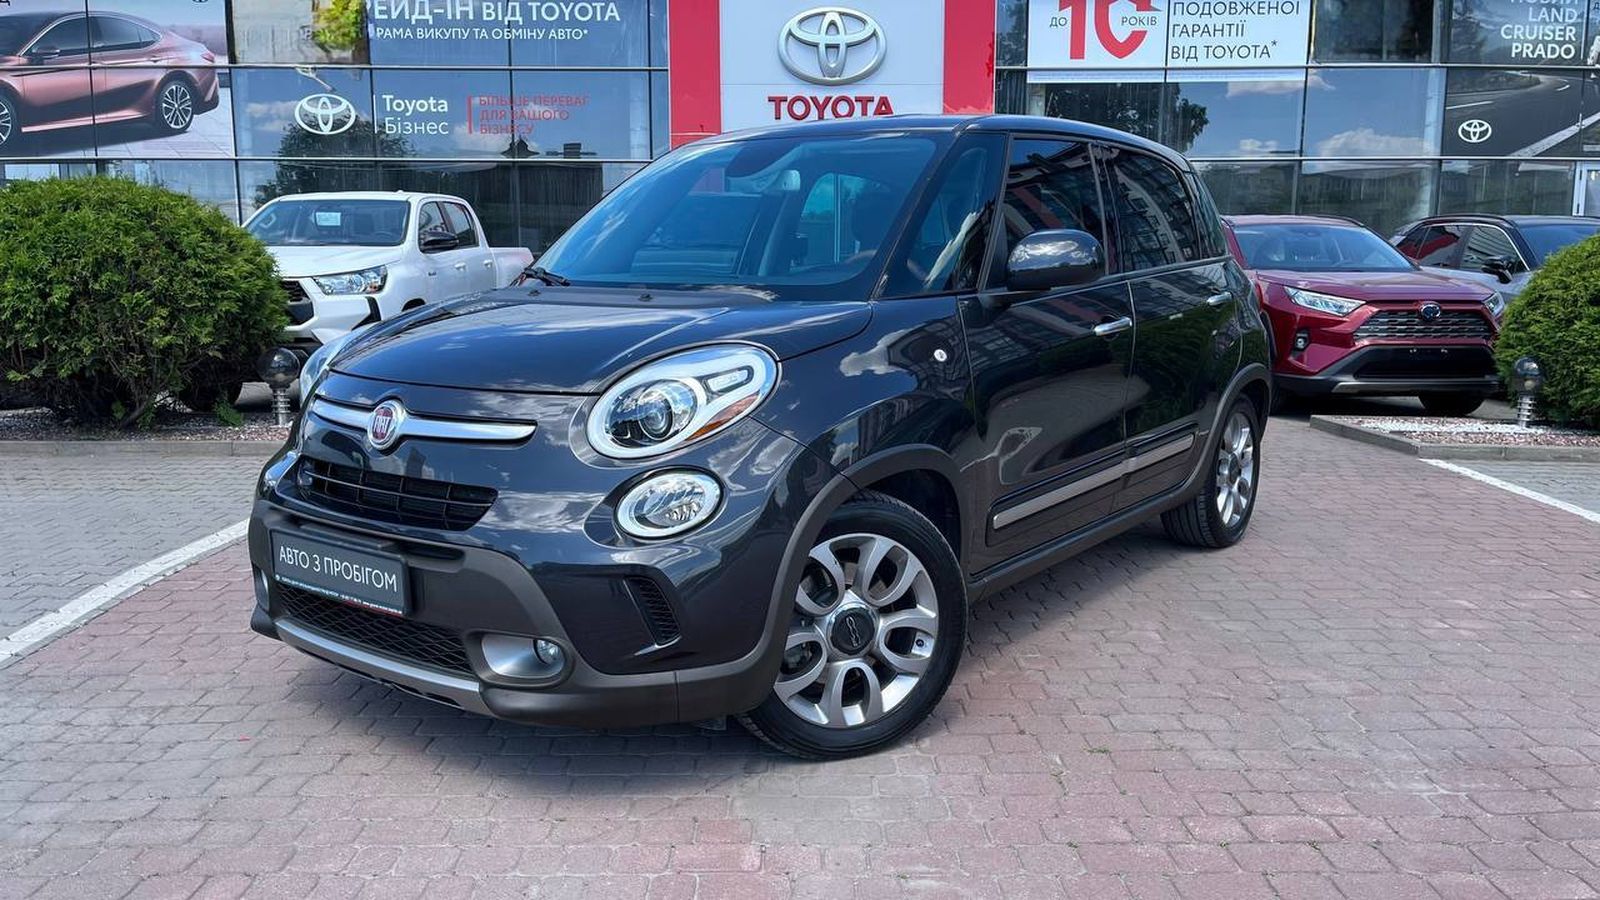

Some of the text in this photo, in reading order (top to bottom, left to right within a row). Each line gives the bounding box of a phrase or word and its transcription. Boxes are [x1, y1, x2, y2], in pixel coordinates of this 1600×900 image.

[482, 2, 523, 24] ВІД
[528, 2, 621, 21] TOYOTA
[1121, 16, 1157, 26] РОКІВ
[1529, 7, 1577, 22] LAND
[1049, 17, 1068, 27] ДО
[1172, 20, 1246, 38] ГАРАНТІЇ
[417, 28, 470, 40] ВИКУПУ
[473, 28, 489, 40] ТА
[492, 28, 546, 40] ОБМІНУ
[1501, 25, 1576, 41] CRUISER
[1171, 45, 1198, 62] ВІД
[1511, 43, 1576, 59] PRADO
[382, 94, 448, 116] Toyota
[768, 95, 894, 120] TOYOTA
[480, 109, 505, 122] ДЛЯ
[385, 117, 449, 134] Бізнес
[374, 415, 391, 434] FIAT
[280, 545, 310, 569] АВТО
[324, 557, 397, 592] ПРОБІГОМ
